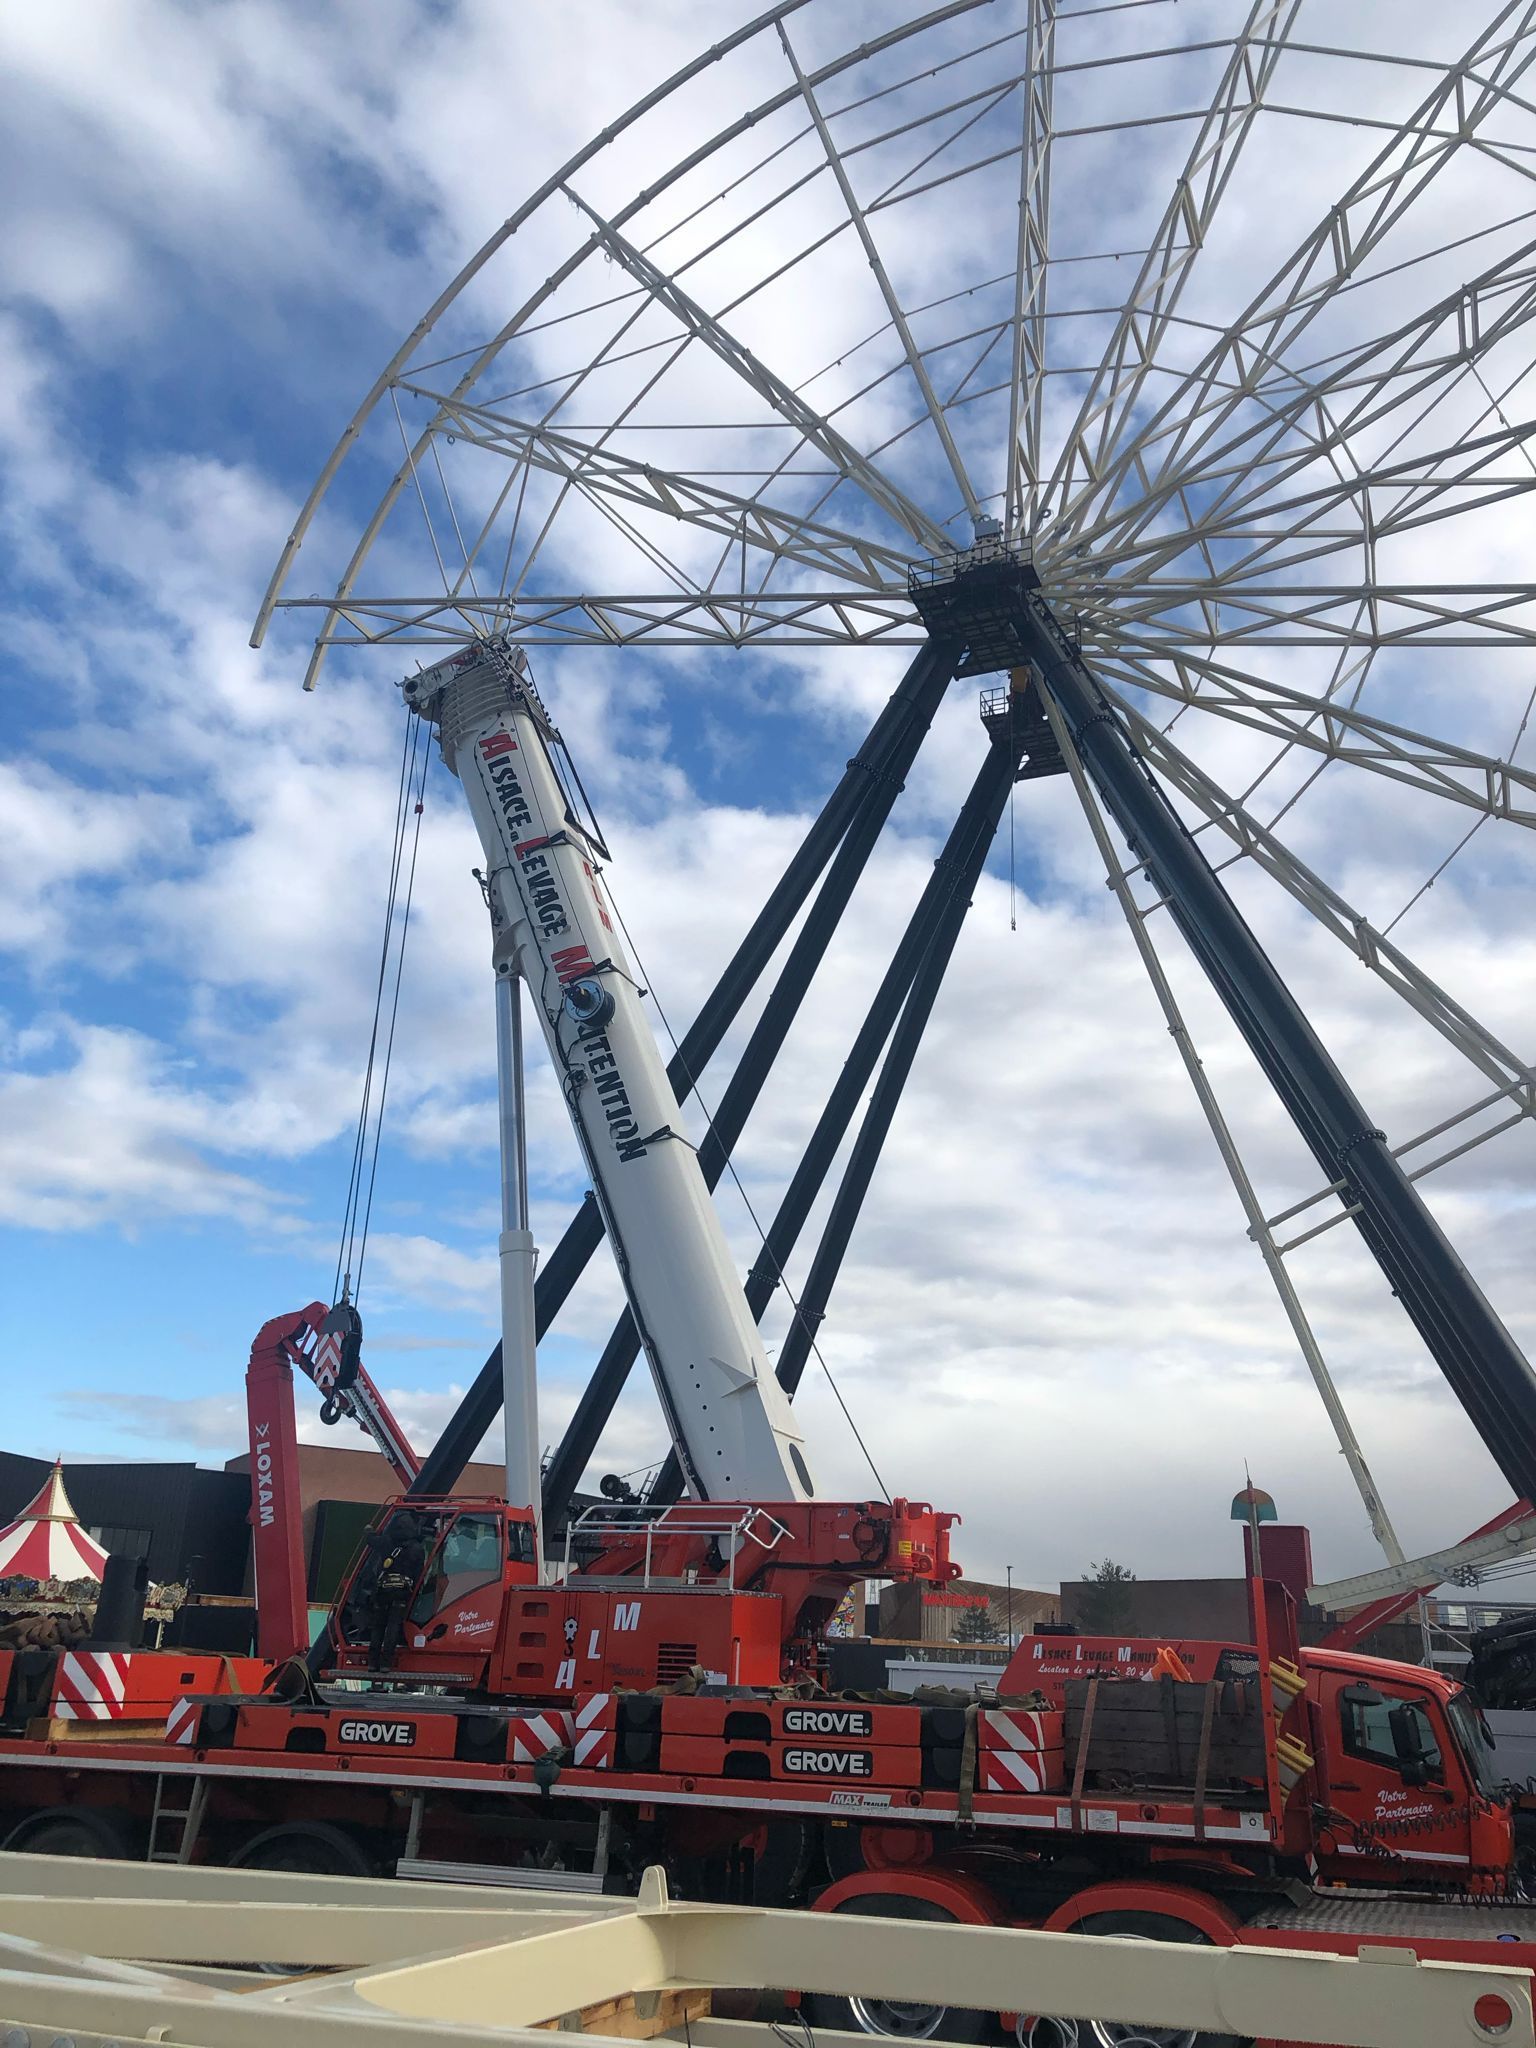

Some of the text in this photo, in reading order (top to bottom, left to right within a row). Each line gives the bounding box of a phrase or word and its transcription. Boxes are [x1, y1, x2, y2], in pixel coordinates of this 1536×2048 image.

[479, 733, 532, 831] ALSACE
[256, 1441, 275, 1528] LOXAM
[458, 1610, 479, 1622] Votre
[454, 1619, 495, 1636] Partenaire
[1038, 1663, 1070, 1674] Location
[1125, 1666, 1137, 1677] 20
[784, 1711, 864, 1734] GROVE
[340, 1722, 410, 1743] GROVE
[784, 1751, 865, 1774] GROVE
[832, 1794, 861, 1806] MAX
[1377, 1789, 1408, 1803] Votre
[1374, 1802, 1434, 1820] Partenaire
